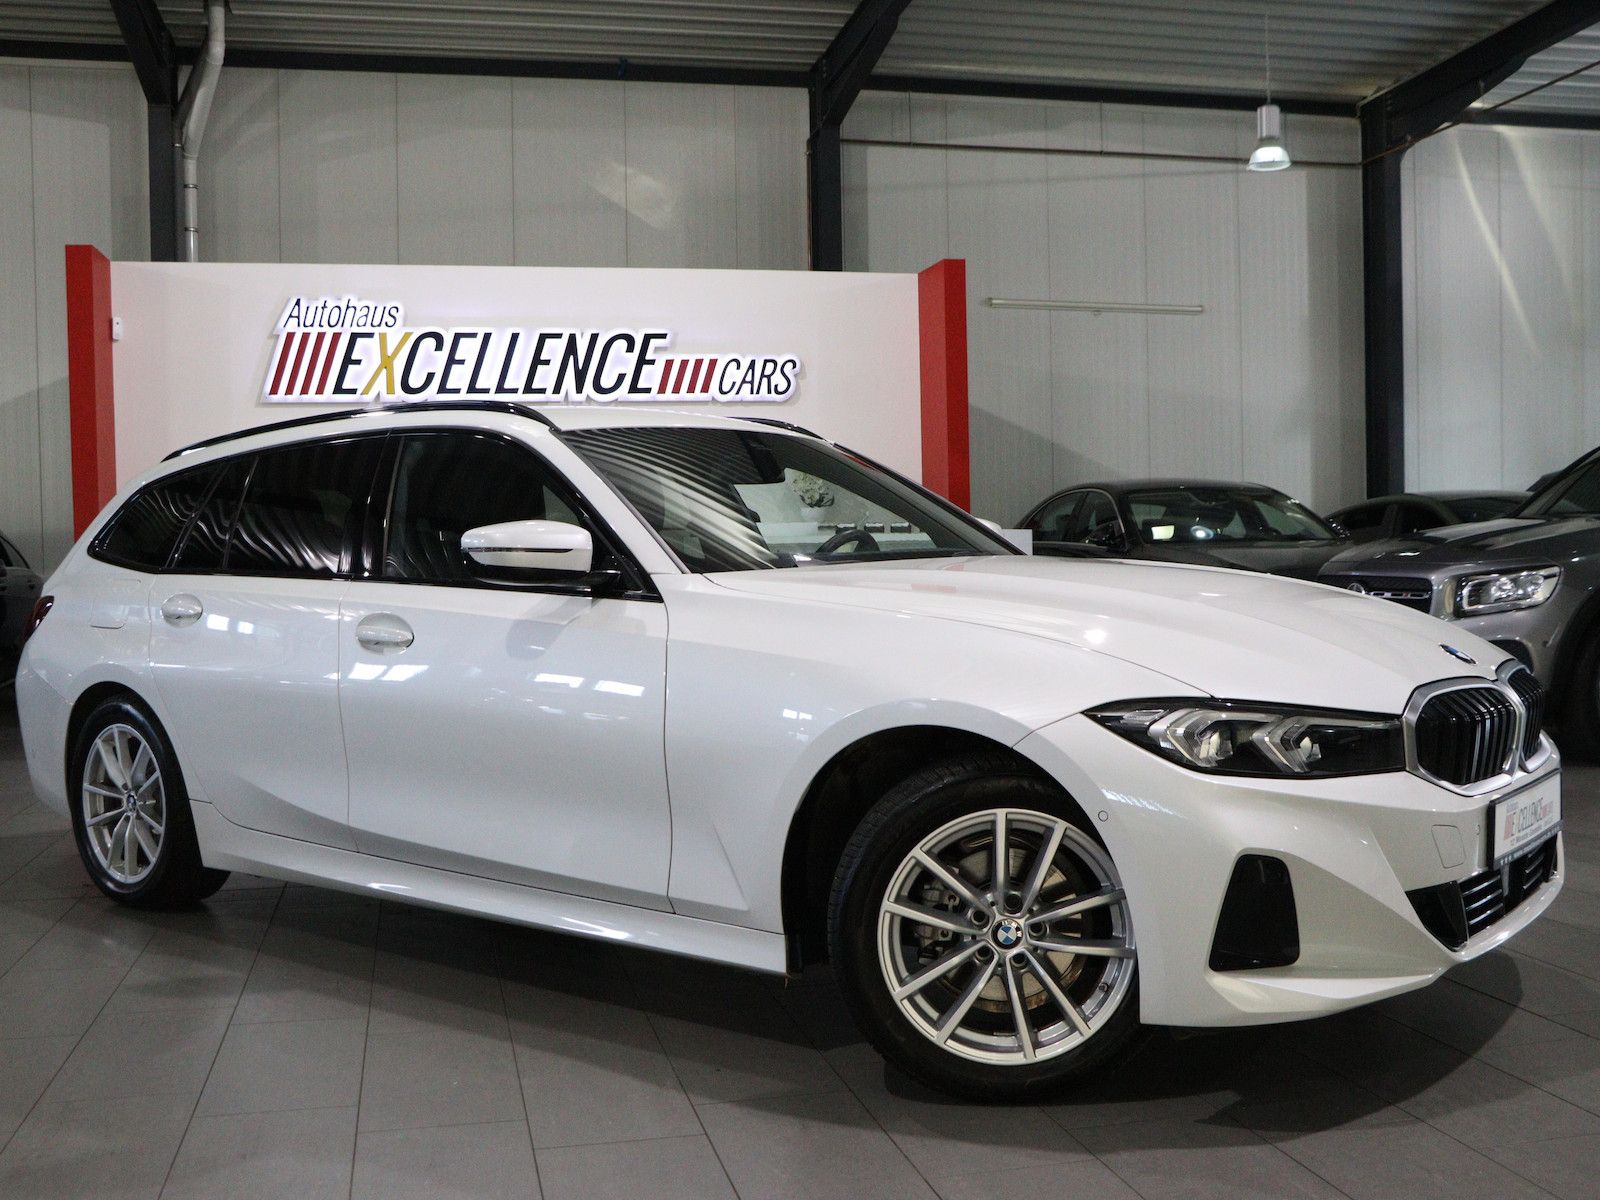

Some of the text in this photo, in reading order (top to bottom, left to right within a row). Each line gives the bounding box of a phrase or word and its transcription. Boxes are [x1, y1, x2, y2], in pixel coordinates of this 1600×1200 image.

[283, 298, 399, 328] Autohaus
[332, 331, 797, 395] EXCELLENCE CARS
[1510, 796, 1544, 837] ECELLENCE
